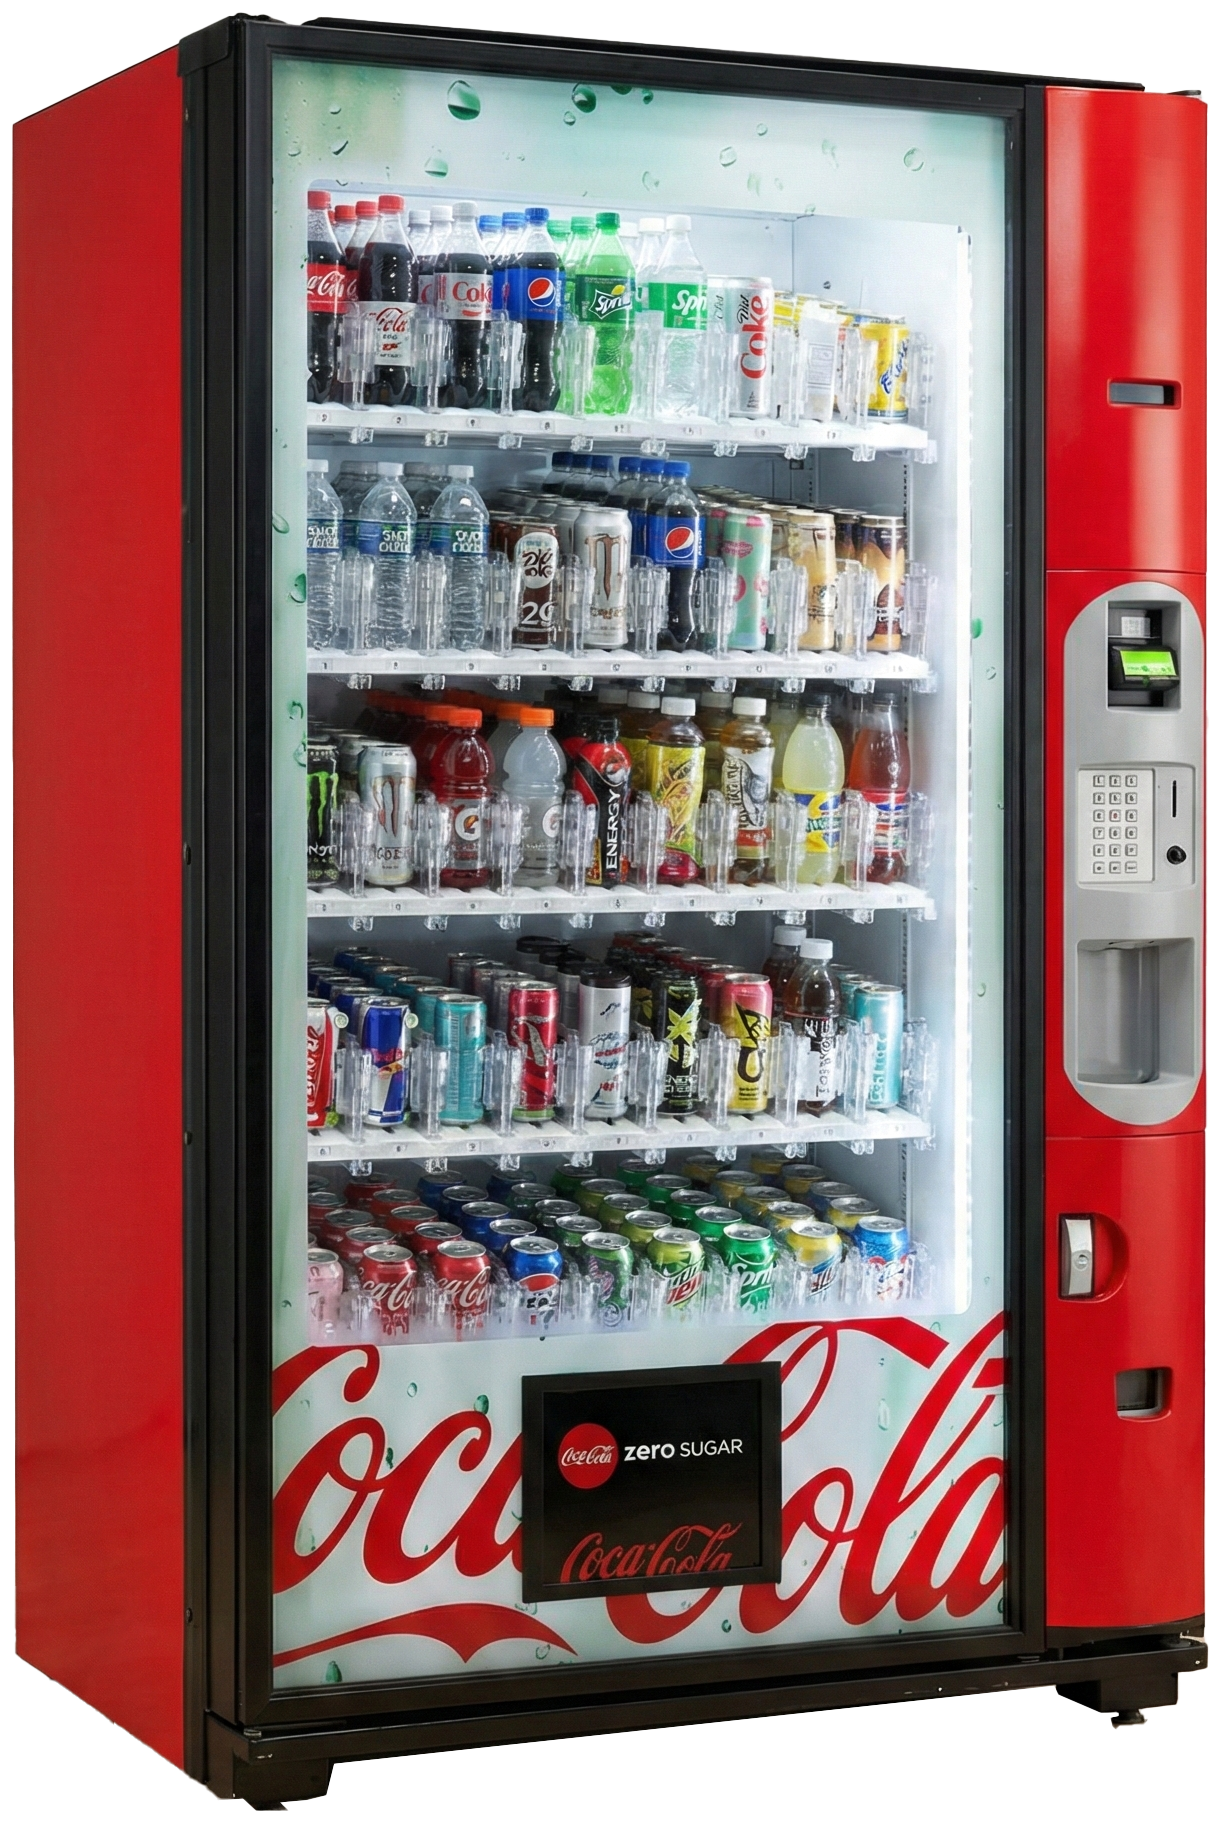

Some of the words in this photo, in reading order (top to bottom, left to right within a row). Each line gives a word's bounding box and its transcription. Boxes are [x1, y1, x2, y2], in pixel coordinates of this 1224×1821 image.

[740, 295, 769, 379] Coke
[605, 789, 621, 869] ENERGY
[623, 1443, 675, 1462] zero
[680, 1438, 743, 1458] SUGAR
